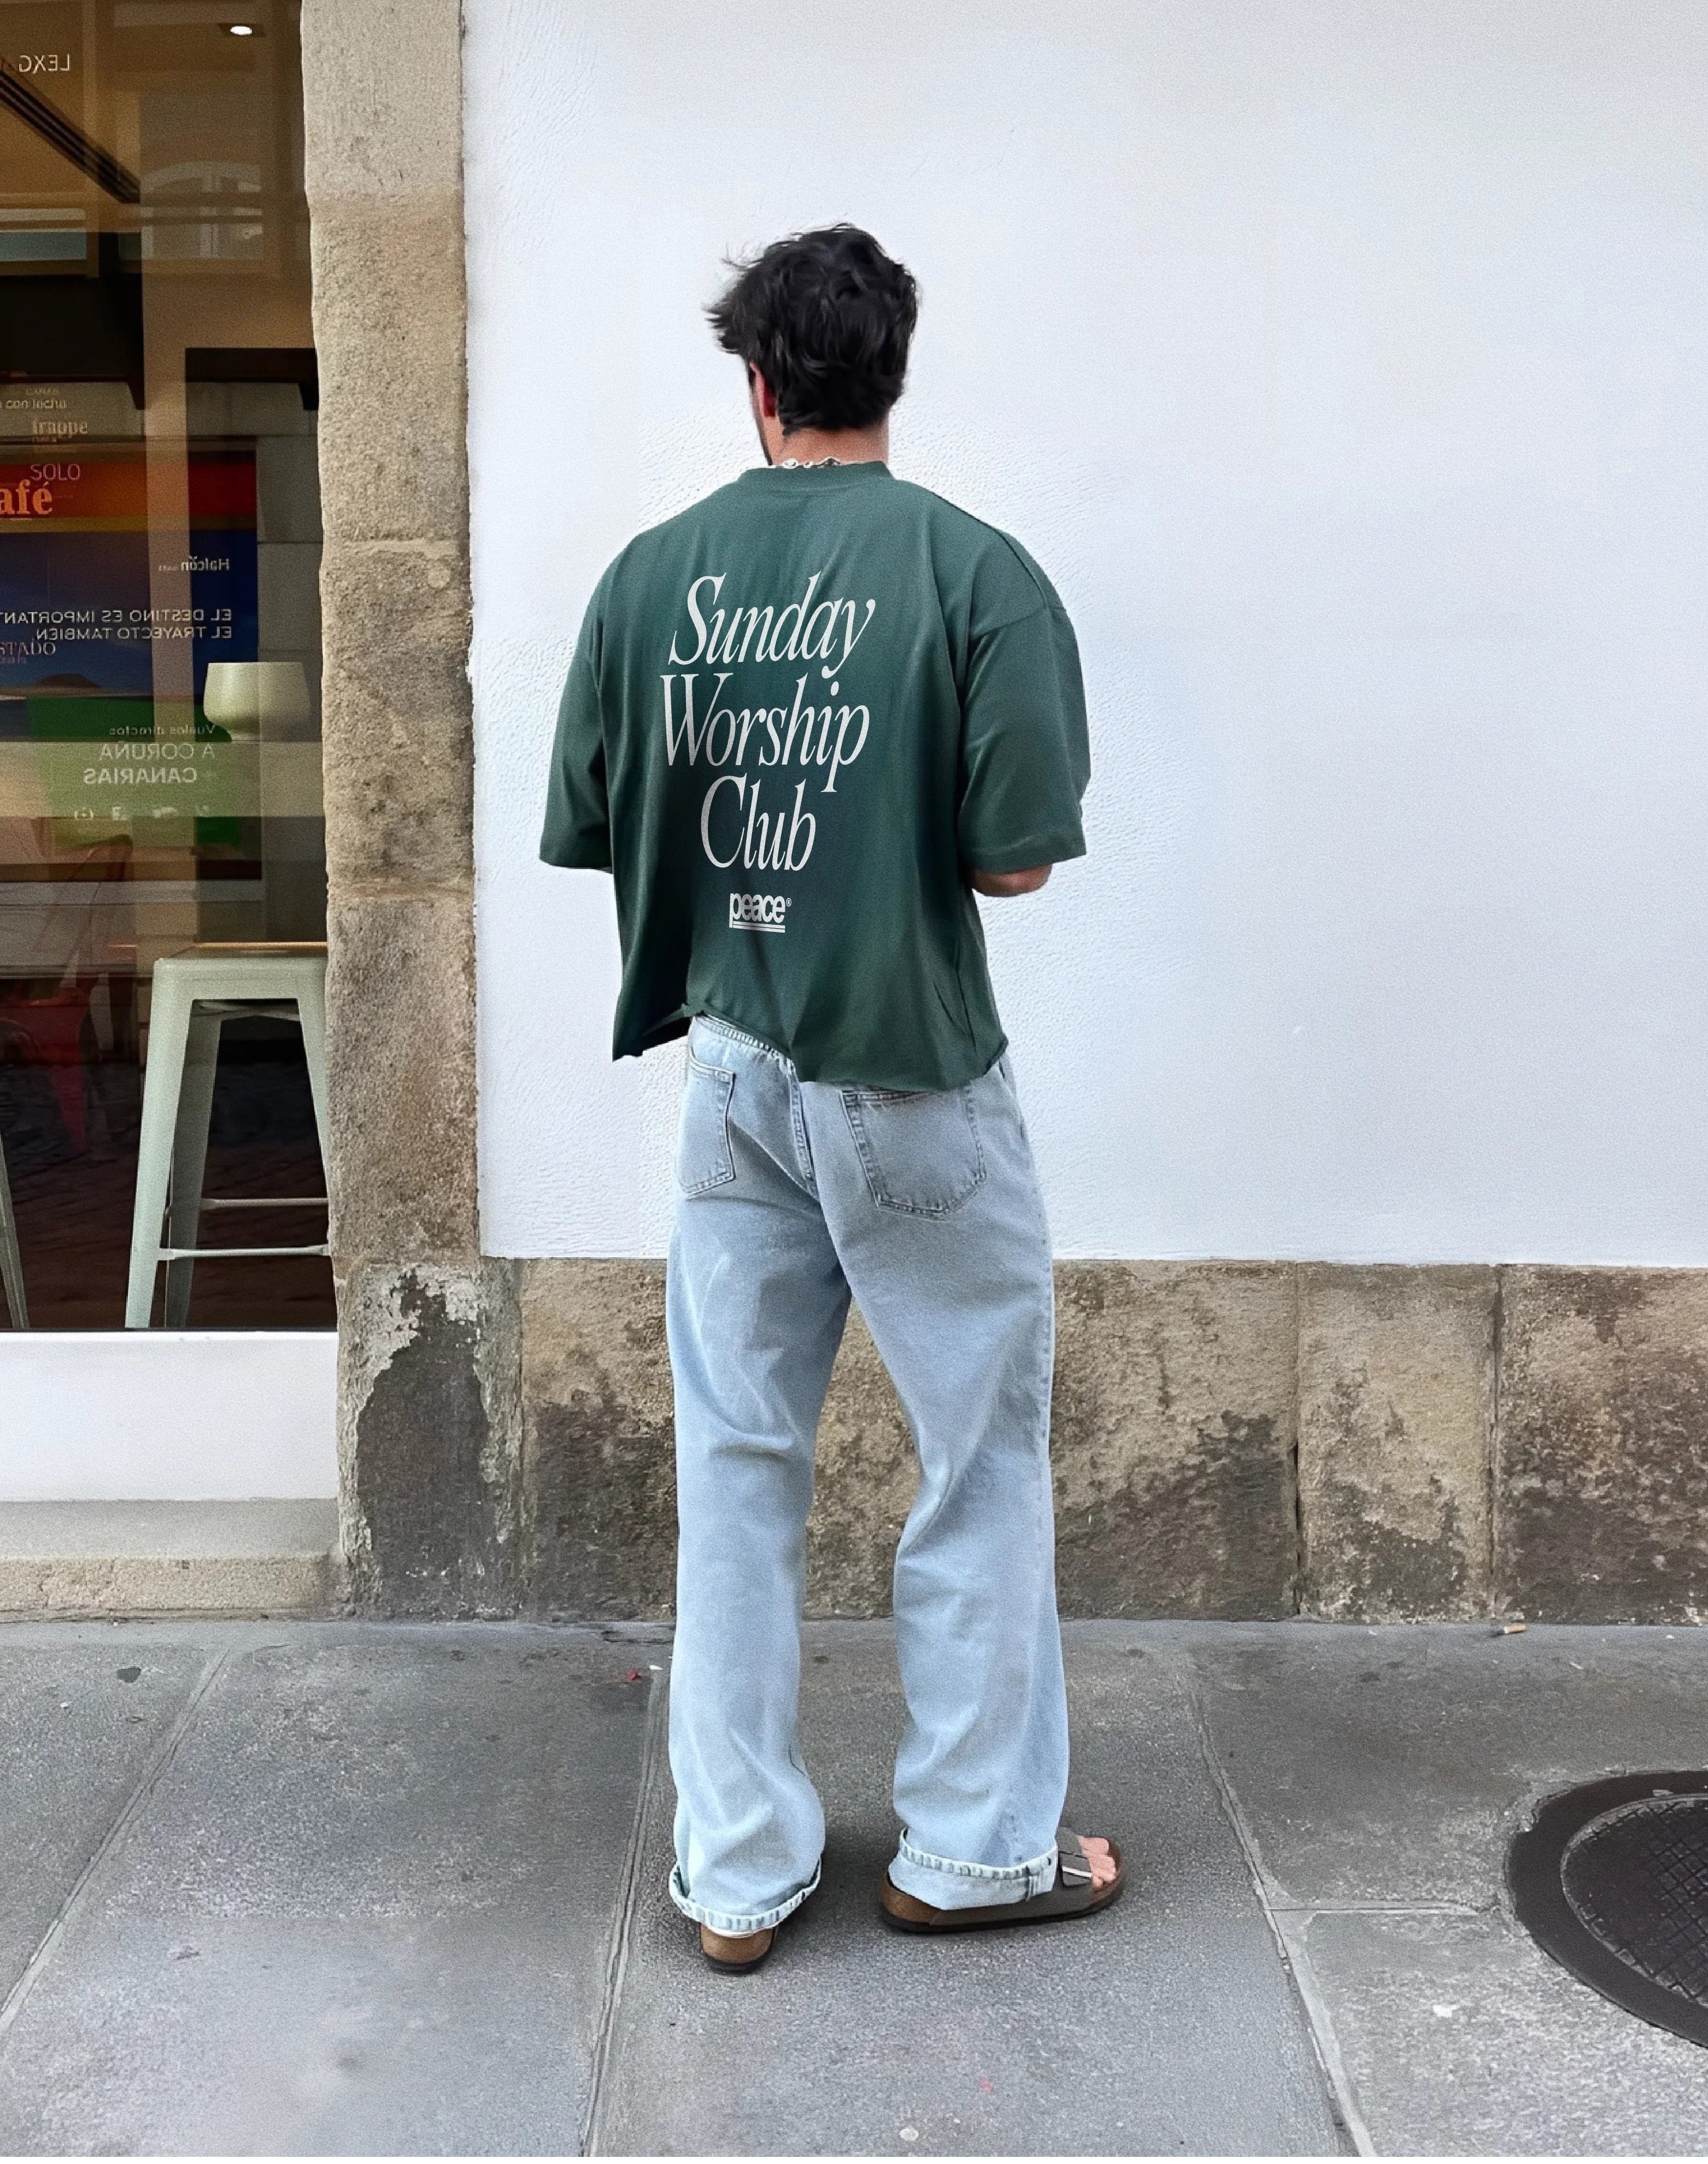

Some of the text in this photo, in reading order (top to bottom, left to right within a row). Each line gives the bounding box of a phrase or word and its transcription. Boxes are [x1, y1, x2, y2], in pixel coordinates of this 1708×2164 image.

[30, 464, 81, 481] SOLO
[668, 571, 876, 679] Sunday
[660, 672, 870, 793] Worship
[701, 772, 816, 871] Club
